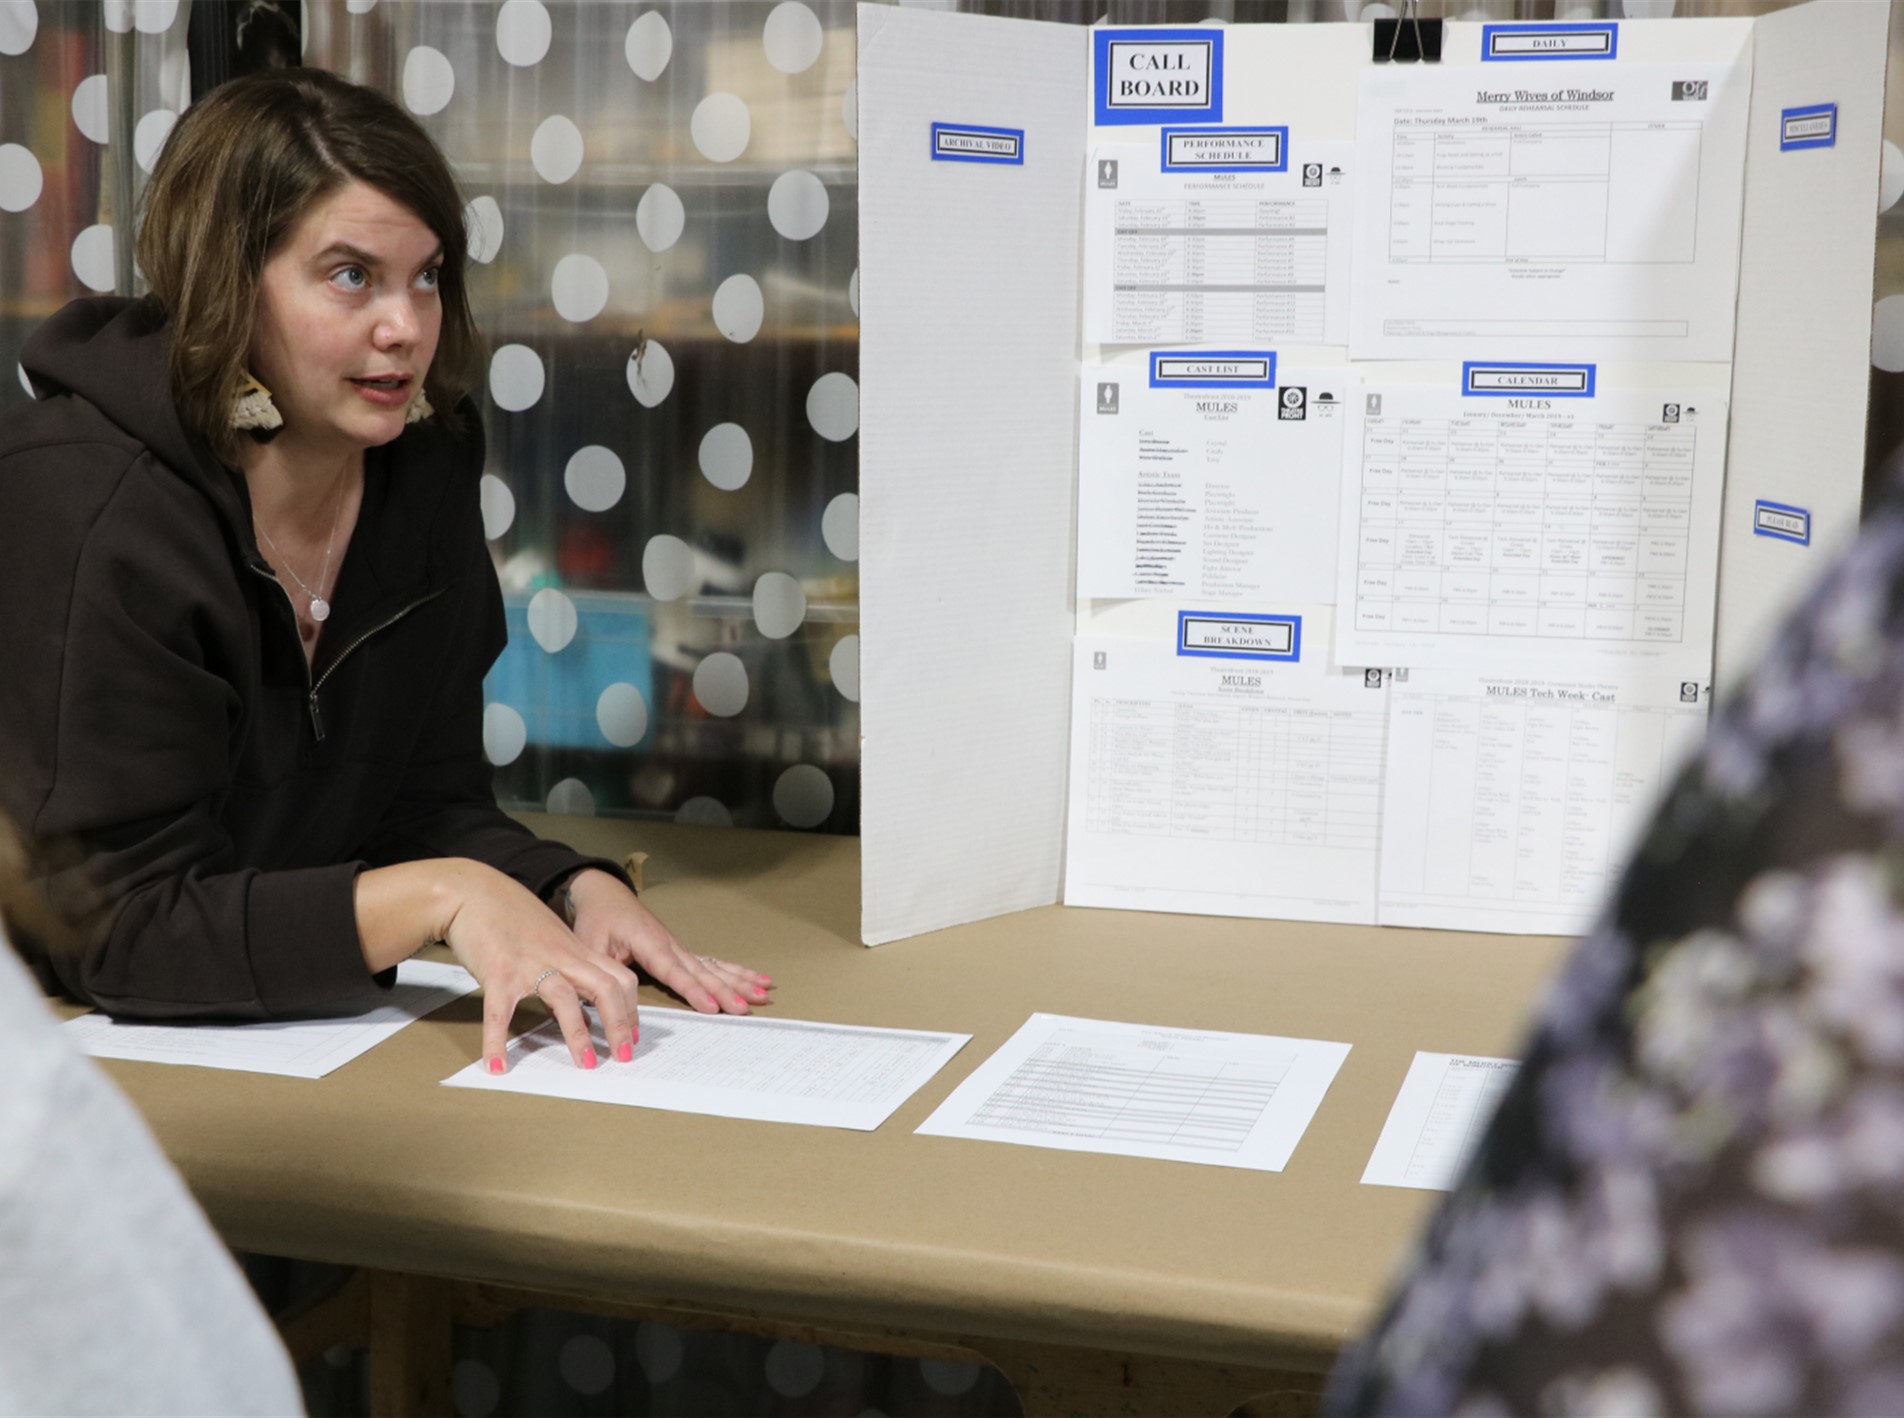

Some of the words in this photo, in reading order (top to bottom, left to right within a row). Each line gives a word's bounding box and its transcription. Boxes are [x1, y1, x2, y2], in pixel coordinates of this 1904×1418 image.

[1532, 38, 1569, 48] DAILY
[1129, 53, 1190, 70] CALL
[1120, 80, 1200, 97] BOARD
[1476, 90, 1511, 104] Merry
[1514, 90, 1548, 103] Wives
[1550, 89, 1564, 102] of
[1566, 88, 1615, 102] Windsor
[1414, 117, 1446, 125] Thursday
[944, 138, 983, 149] ARCHIVAL
[987, 141, 1011, 150] VIDEO
[1183, 138, 1265, 148] PERFORMANCE
[1194, 150, 1253, 160] SCHEDULE
[1186, 365, 1214, 374] CAST
[1215, 364, 1240, 374] LIST
[1497, 376, 1559, 385] CALENDAR
[1195, 402, 1238, 413] MULES
[1507, 399, 1552, 410] MULES
[1221, 624, 1255, 635] SCENE
[1203, 636, 1272, 647] BREAKDOWN
[1221, 675, 1262, 687] MULES
[1486, 685, 1527, 698] MULES
[1529, 688, 1554, 699] Tech
[1591, 692, 1616, 702] Cast
